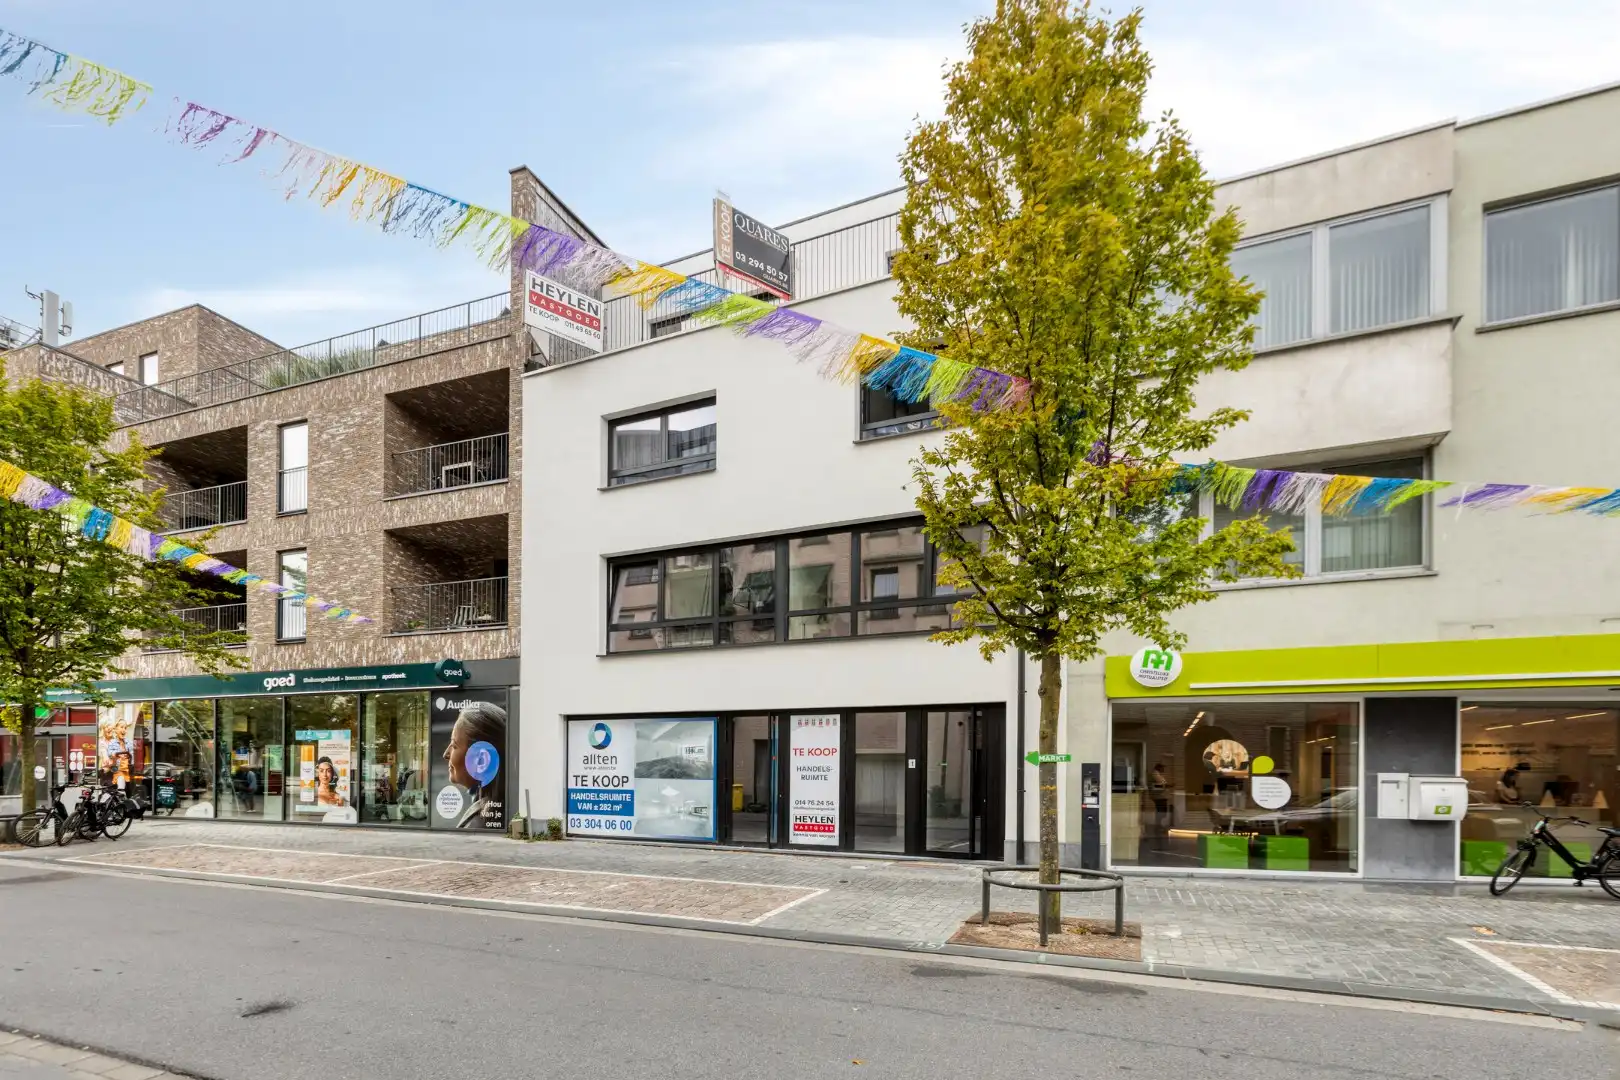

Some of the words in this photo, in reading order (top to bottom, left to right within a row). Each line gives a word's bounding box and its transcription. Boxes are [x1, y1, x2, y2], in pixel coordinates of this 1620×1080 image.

[721, 203, 731, 241] KOOP
[734, 213, 788, 252] QUARES
[721, 243, 731, 259] TE
[735, 251, 746, 263] 03
[748, 257, 765, 271] 294
[766, 265, 777, 277] 50
[778, 271, 788, 282] 57
[531, 277, 599, 317] HEYLEN
[531, 293, 600, 328] VASTGOED
[528, 305, 538, 316] TE
[538, 309, 560, 322] KOOP
[564, 320, 575, 331] 011
[443, 668, 463, 677] goed
[263, 672, 296, 691] goed
[446, 699, 480, 710] Audika
[793, 747, 805, 757] TE
[807, 747, 838, 757] KOOP
[582, 753, 618, 765] allten
[796, 765, 835, 773] HANDELS-
[573, 775, 589, 787] TE
[592, 775, 630, 787] KOOP
[570, 792, 632, 802] HANDELSRUIMTE
[577, 802, 593, 811] VAN
[599, 803, 612, 811] 282
[494, 811, 502, 819] je
[794, 815, 834, 824] HEYLEN
[570, 817, 582, 828] 03
[584, 818, 602, 829] 304
[604, 819, 617, 830] 06
[619, 819, 633, 831] 00
